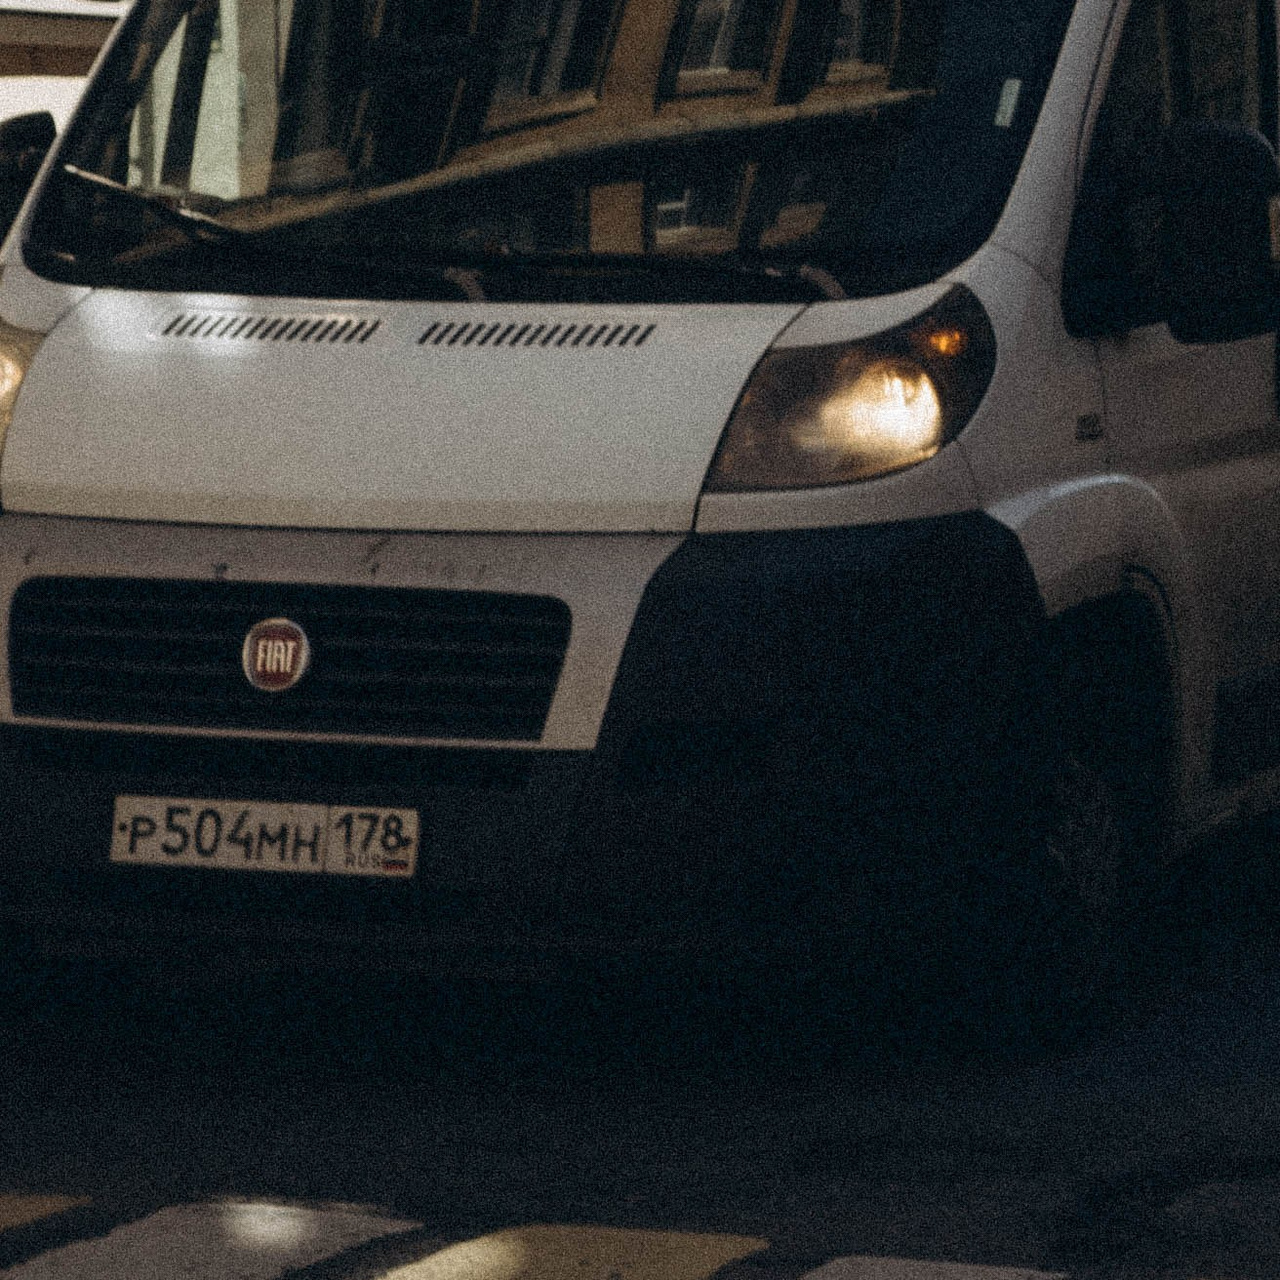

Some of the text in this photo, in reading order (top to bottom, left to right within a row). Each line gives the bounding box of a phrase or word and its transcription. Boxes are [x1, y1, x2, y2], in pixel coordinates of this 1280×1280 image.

[256, 637, 298, 673] FIAT
[336, 812, 405, 854] 178
[344, 851, 381, 869] RUS
